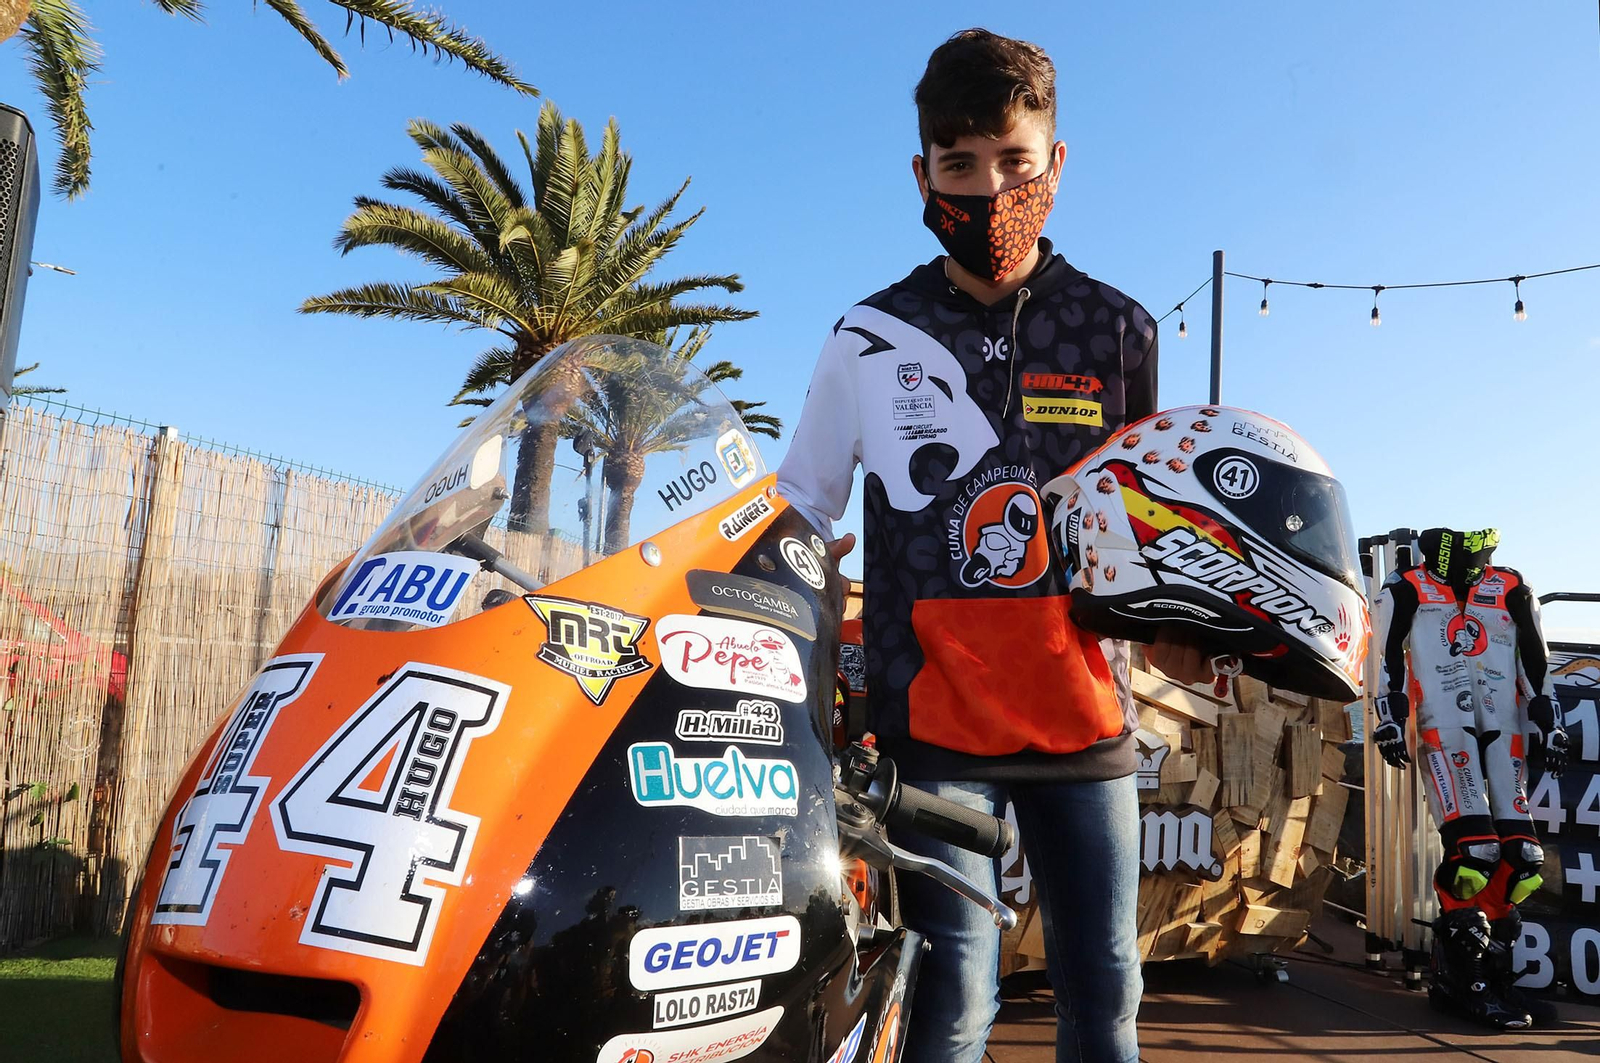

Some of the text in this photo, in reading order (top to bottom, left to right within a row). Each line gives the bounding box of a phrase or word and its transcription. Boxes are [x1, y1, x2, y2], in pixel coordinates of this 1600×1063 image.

[1035, 406, 1098, 417] DUNLOP
[1232, 427, 1297, 463] GESTIA
[657, 461, 717, 511] HUGO
[1221, 465, 1250, 490] 41
[948, 465, 1037, 560] CUNA DE CAMPEONES
[1069, 514, 1079, 545] HUGO
[793, 549, 819, 575] 41
[1141, 526, 1330, 633] SCORPION
[711, 585, 799, 617] OCTOGAMBA
[1153, 603, 1210, 619] SCORPION
[358, 604, 445, 624] grupo promotor
[715, 636, 761, 653] Abuelo
[1440, 627, 1449, 647] CUNA
[554, 656, 635, 677] MURIEL RACING
[661, 631, 769, 685] Pepe
[743, 705, 774, 719] #44
[391, 707, 459, 822] HUGO
[631, 745, 797, 801] Huelva
[715, 804, 797, 816] ciudad que marca
[681, 878, 781, 897] GESTIA
[681, 898, 705, 909] GESTIA
[706, 897, 730, 908] OBRAS
[737, 895, 769, 907] SERVICIOS
[643, 929, 791, 974] GEOJET
[655, 987, 755, 1024] LOLO RASTA
[667, 1046, 704, 1063] SHK
